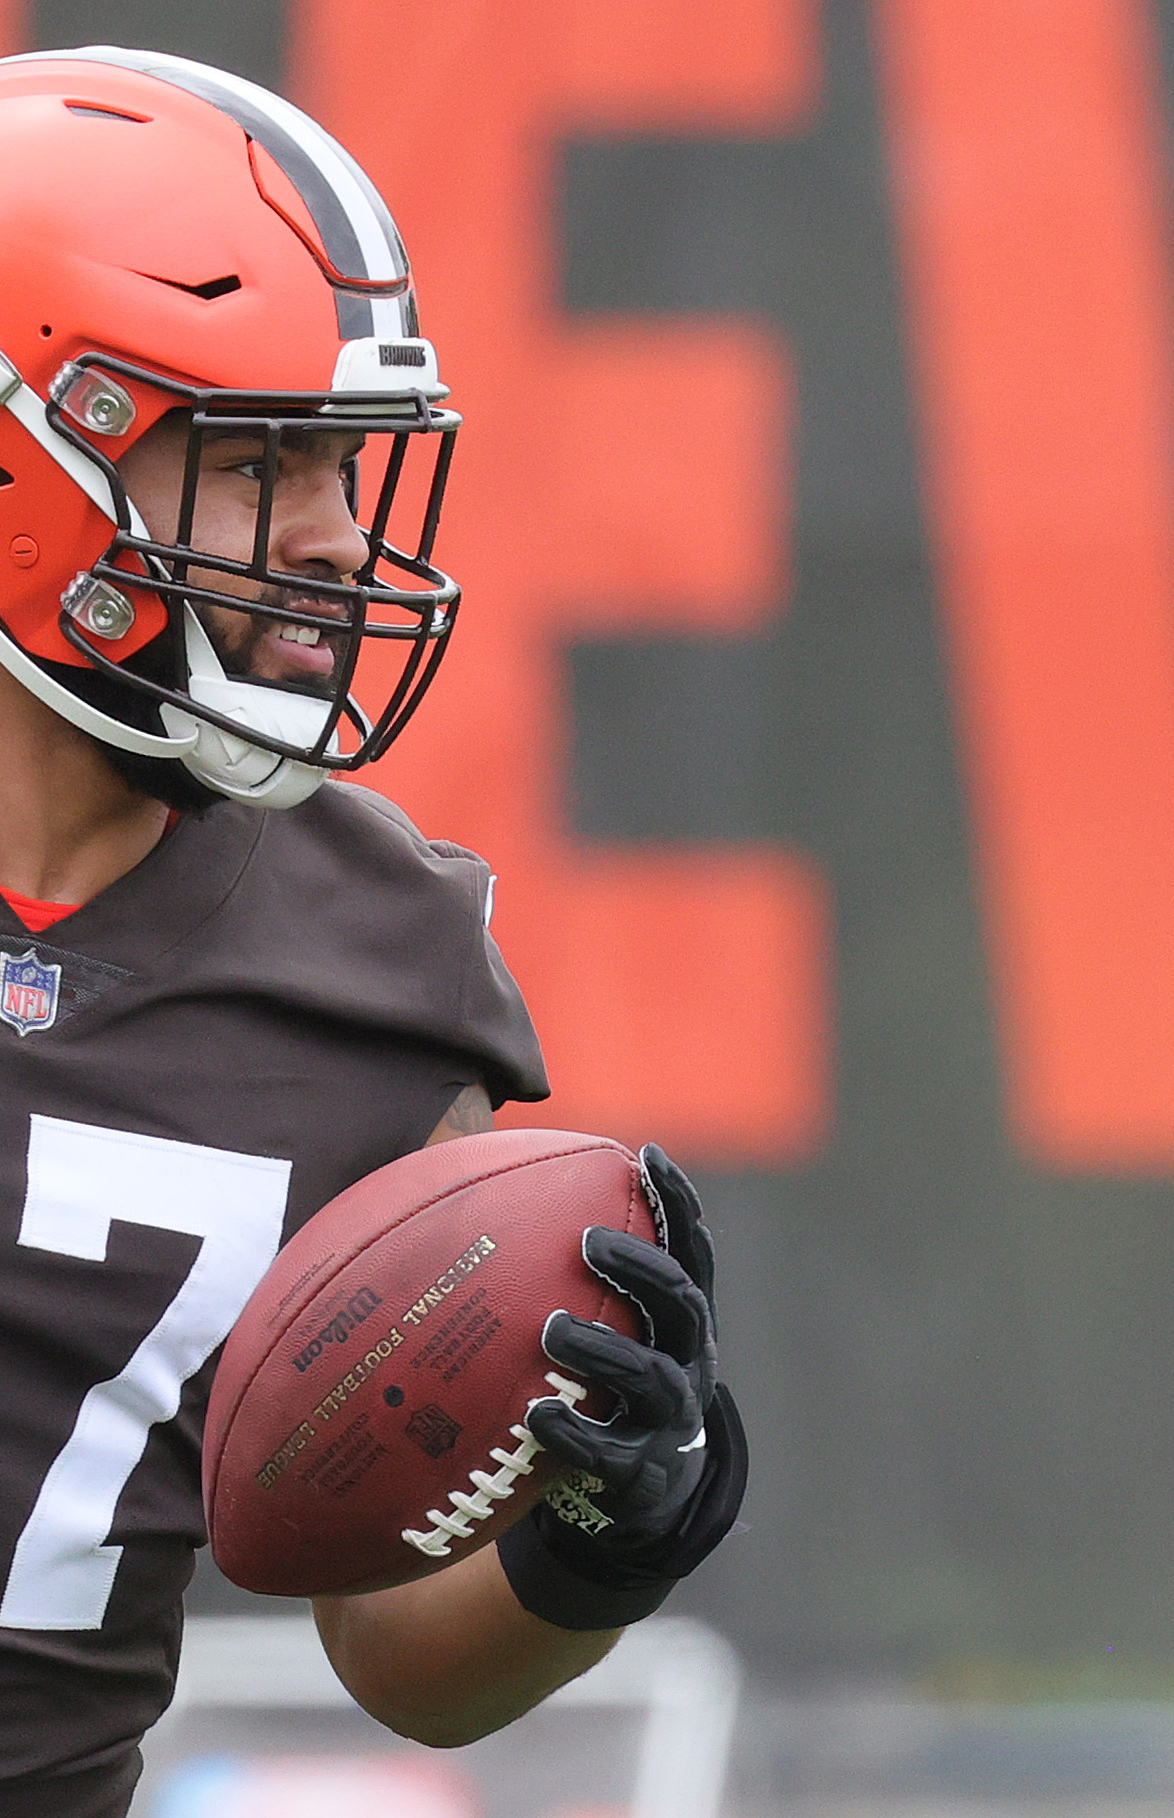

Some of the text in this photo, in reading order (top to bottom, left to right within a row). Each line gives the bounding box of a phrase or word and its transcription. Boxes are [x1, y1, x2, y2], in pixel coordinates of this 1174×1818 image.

[5, 984, 48, 1018] NFL
[399, 1233, 498, 1324] NATIONAL
[291, 1285, 384, 1374] Wilson
[312, 1325, 405, 1420] FOOTBALL
[255, 1420, 317, 1489] LEAGUE
